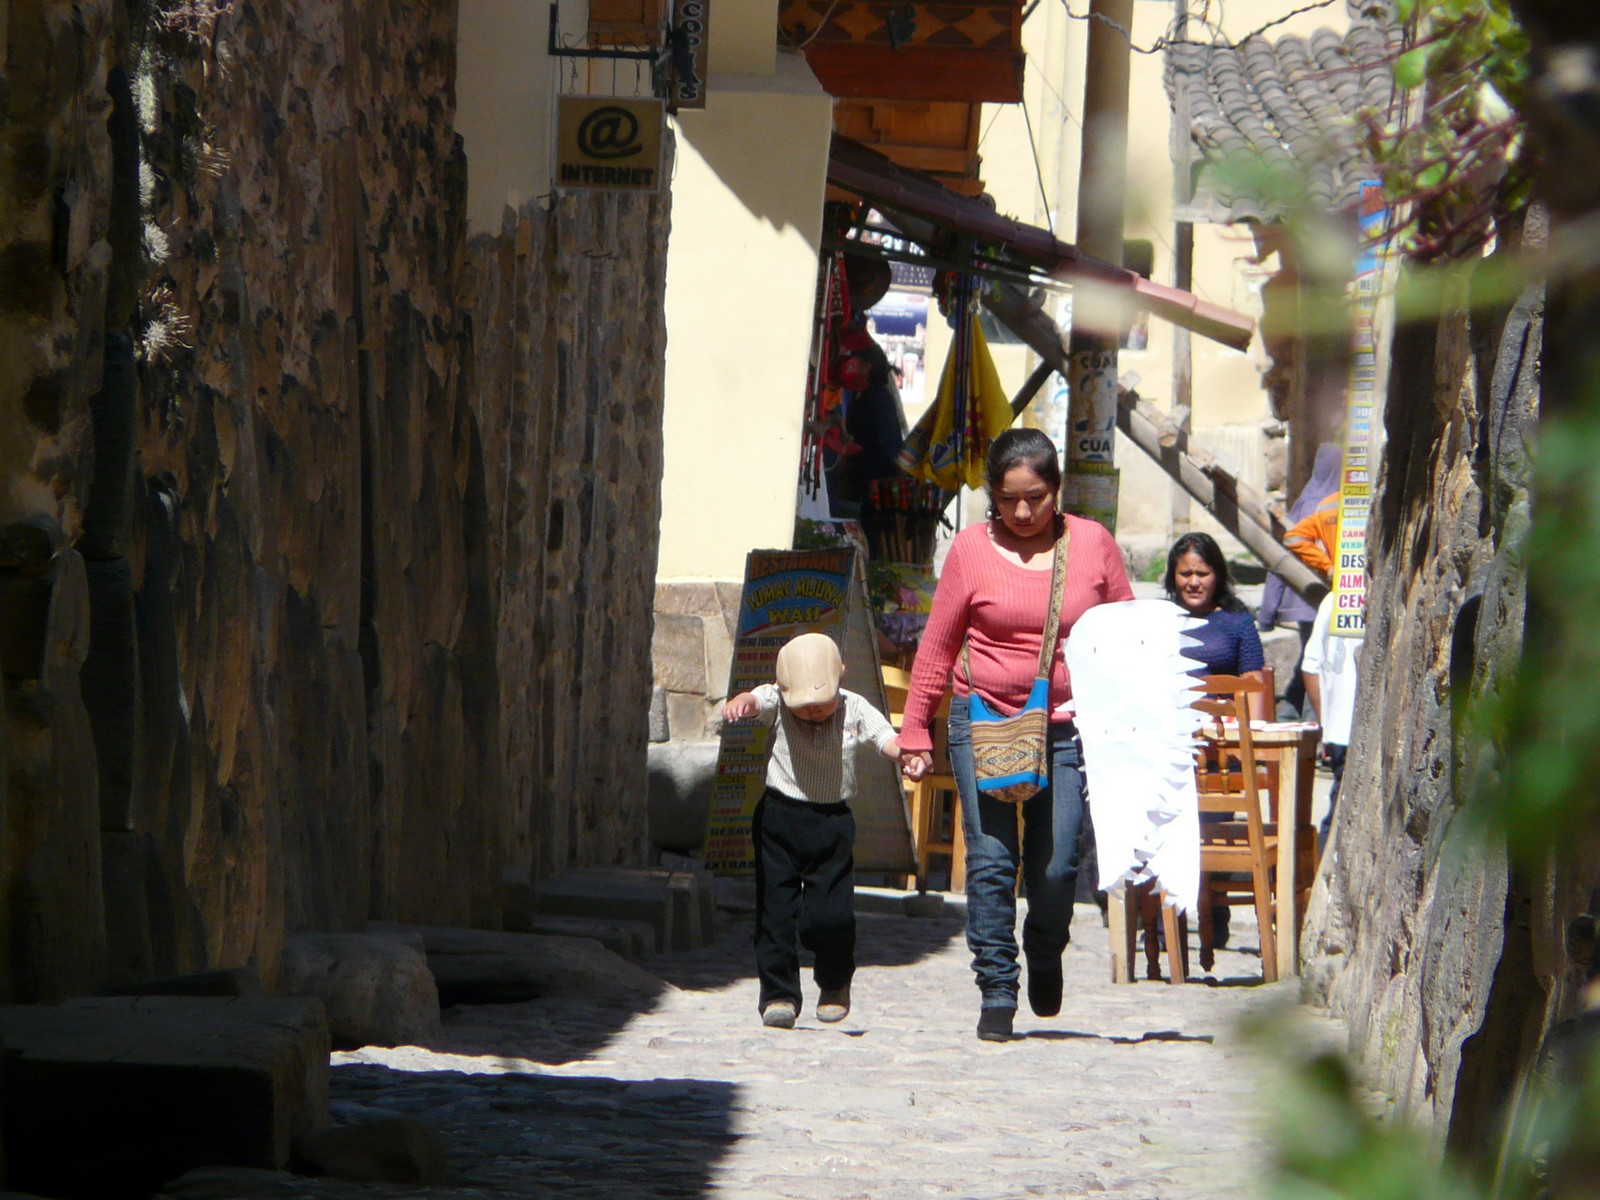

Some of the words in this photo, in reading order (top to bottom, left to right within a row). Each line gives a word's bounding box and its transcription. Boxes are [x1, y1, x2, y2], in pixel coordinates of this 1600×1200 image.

[561, 164, 654, 186] INTERNET
[1341, 554, 1365, 569] DES
[1339, 574, 1366, 589] ALM
[746, 577, 792, 613] SUMAC
[794, 575, 847, 609] MIJUNA
[767, 605, 821, 624] WASI
